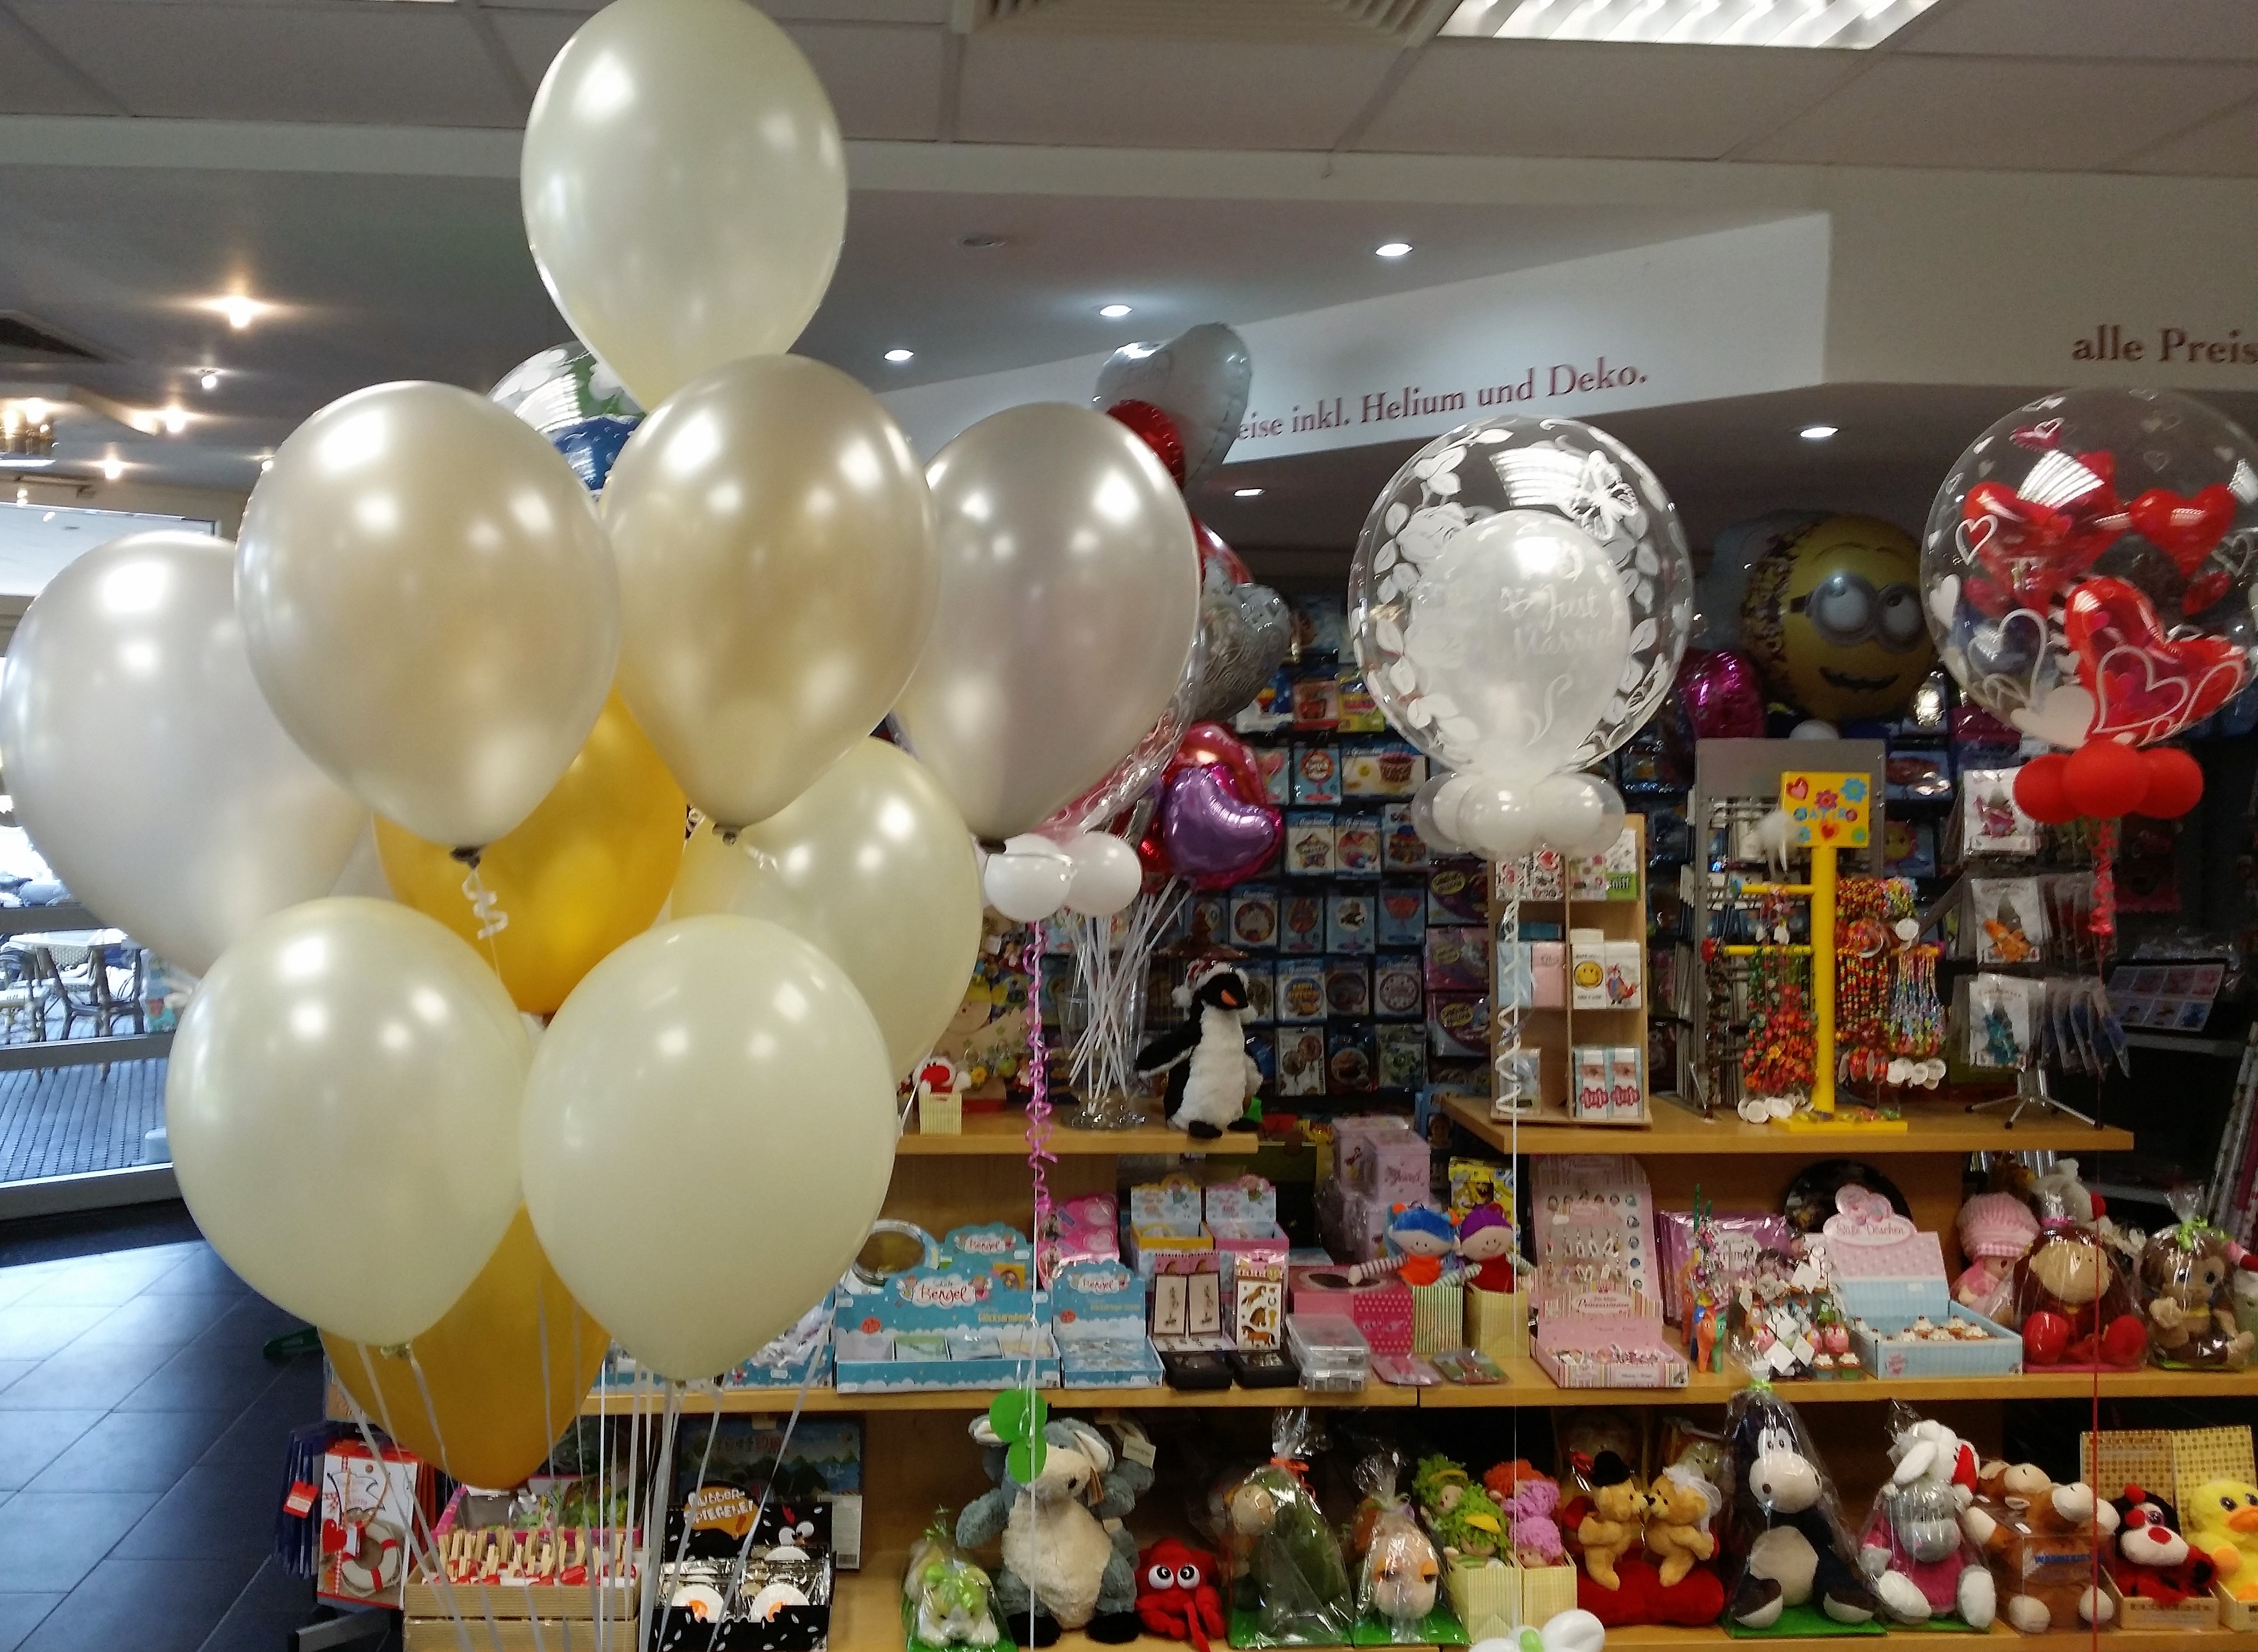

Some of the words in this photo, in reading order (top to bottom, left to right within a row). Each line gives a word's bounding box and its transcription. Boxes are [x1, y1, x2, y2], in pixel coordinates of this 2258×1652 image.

[2071, 324, 2144, 362] alle
[1237, 411, 1283, 439] eise
[1291, 397, 1350, 433] inkl.
[1360, 385, 1464, 423] Helium
[1478, 366, 1536, 406] und
[1546, 356, 1647, 397] Deko.
[1542, 583, 1599, 633] Just
